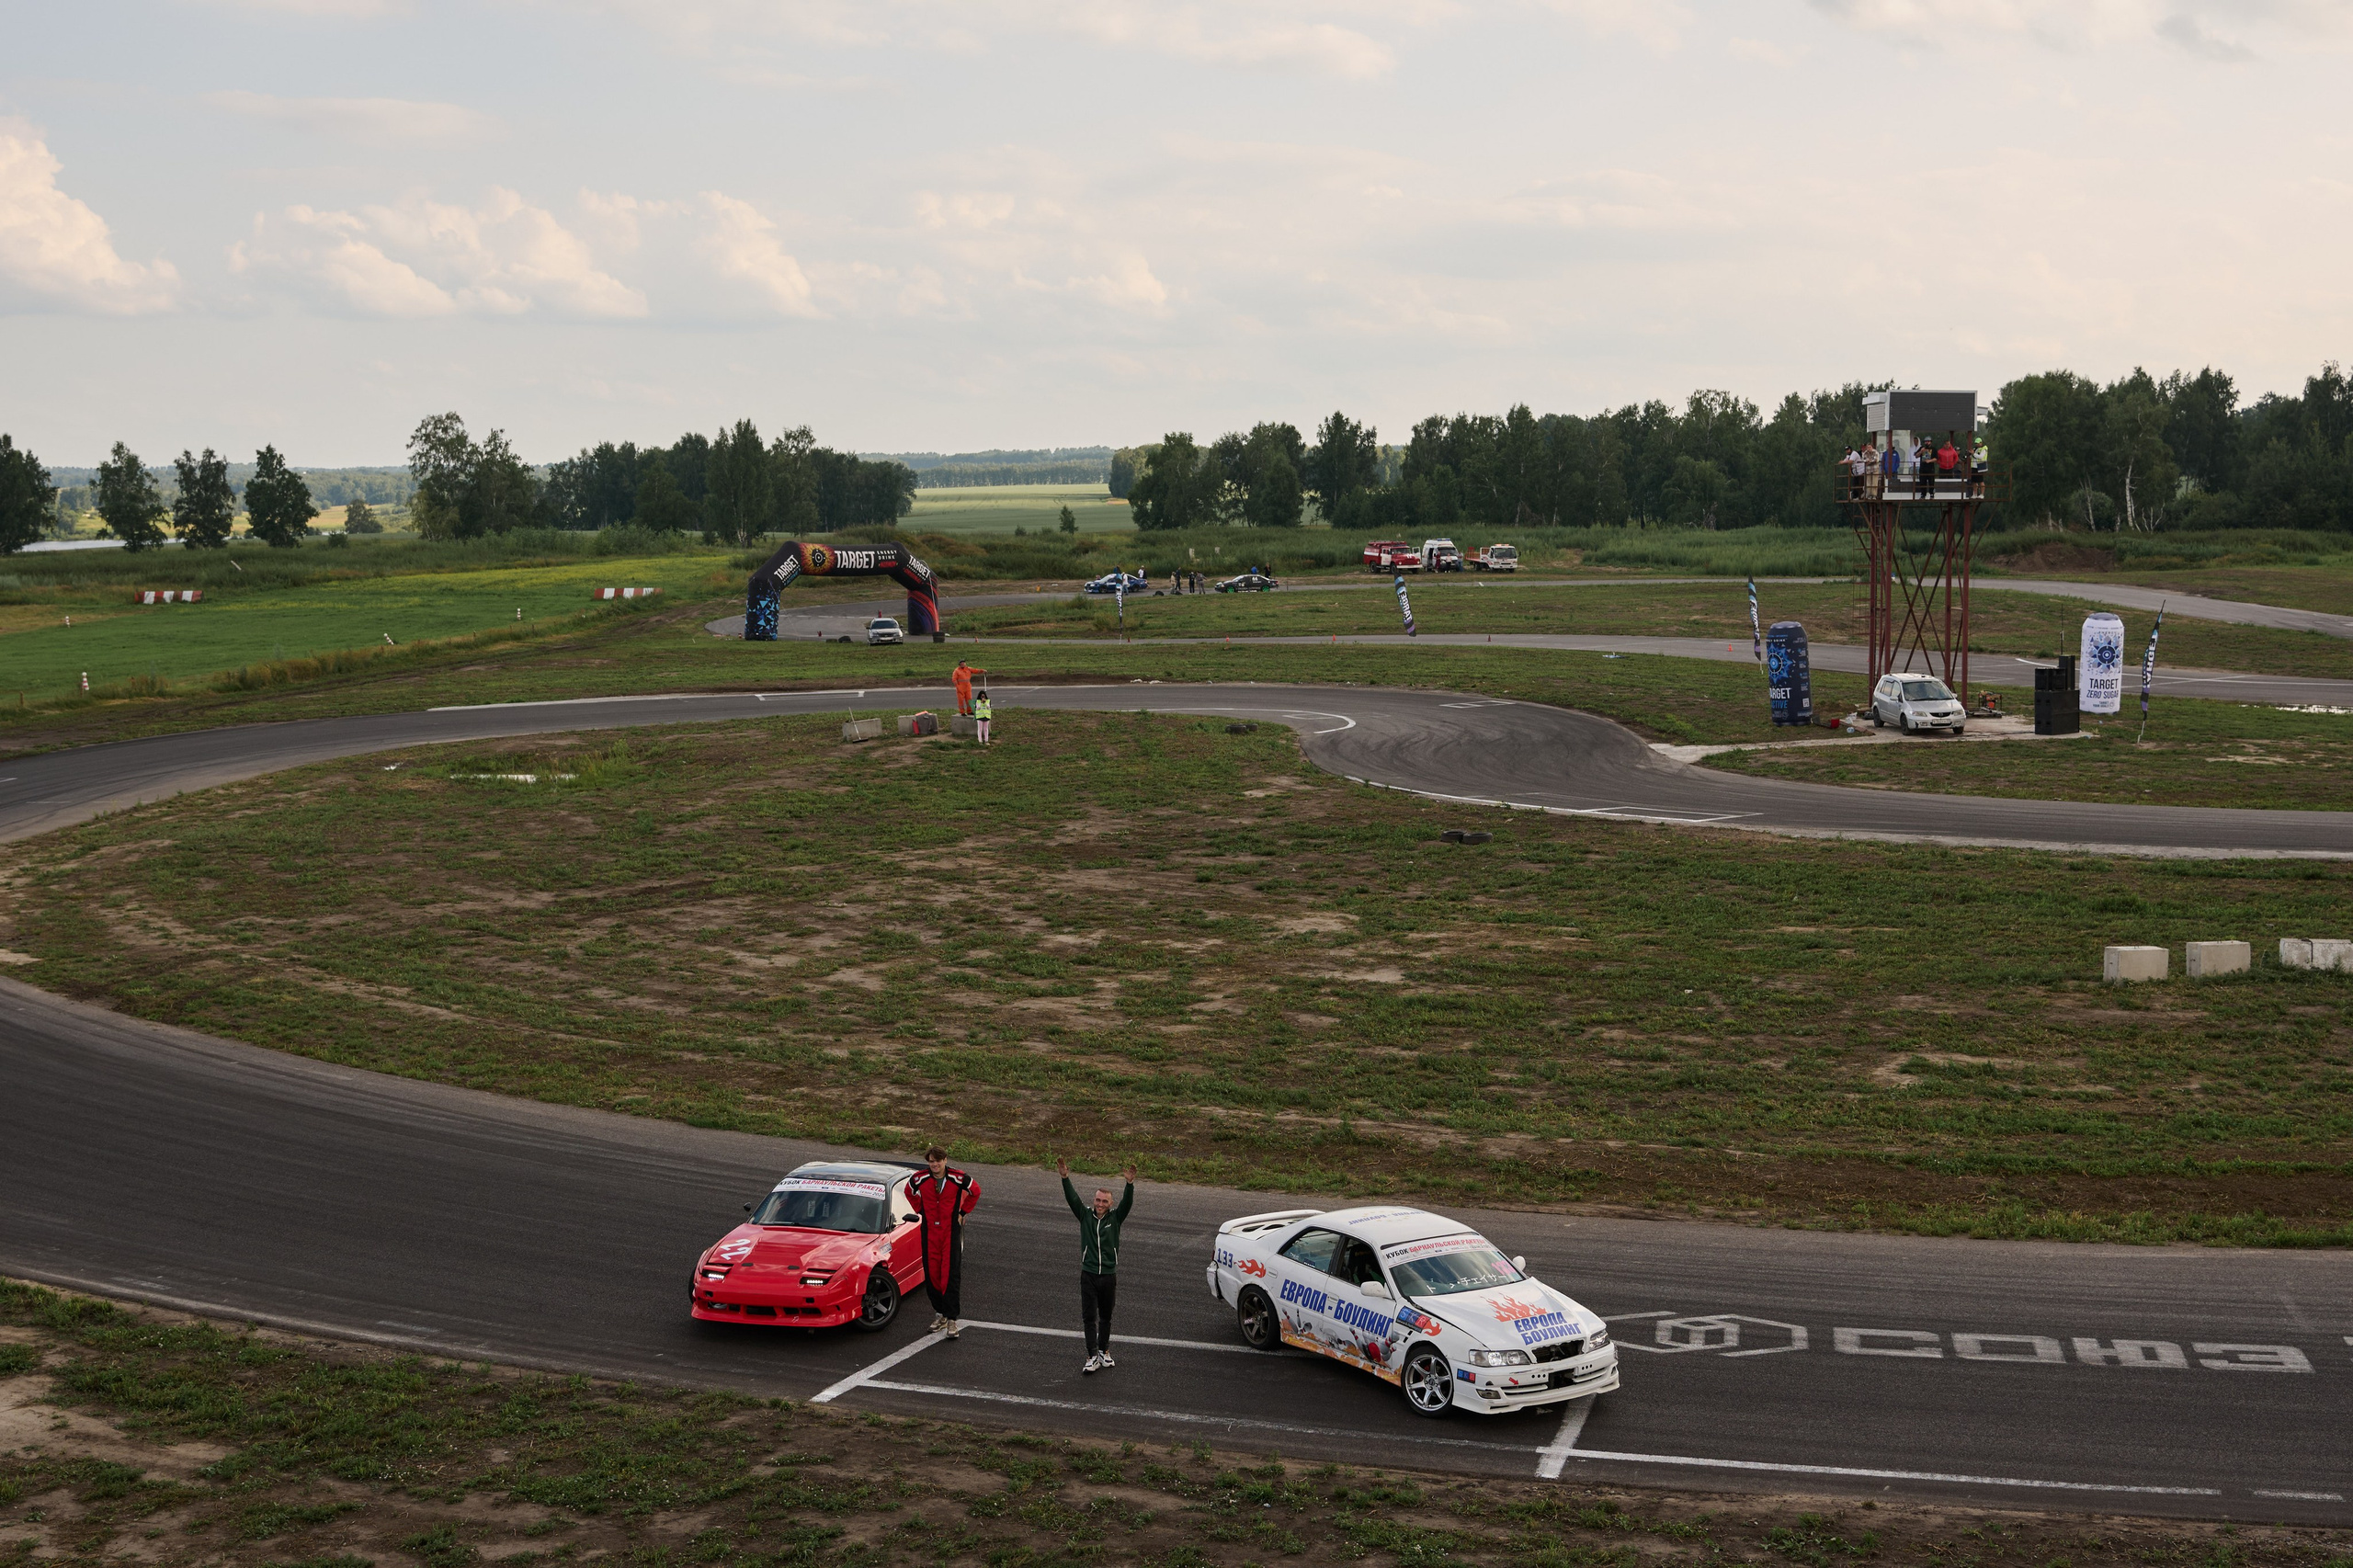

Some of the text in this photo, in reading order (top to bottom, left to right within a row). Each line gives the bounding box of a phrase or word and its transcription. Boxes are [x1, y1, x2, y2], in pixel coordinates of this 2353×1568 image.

[774, 554, 800, 580] TARGET
[835, 551, 875, 569] TARGET
[908, 554, 931, 577] TARGET
[1769, 687, 1791, 699] ARGET
[2089, 678, 2119, 689] TARGET
[1771, 700, 1788, 709] CTIVE
[2086, 690, 2102, 699] ZERO
[857, 1184, 885, 1193] РАКЕТЫ
[720, 1238, 752, 1260] 22
[1217, 1247, 1233, 1268] 133
[1385, 1247, 1410, 1259] КУБОК
[1409, 1240, 1461, 1253] БАРНАУЛЬСКОЙ
[1279, 1278, 1328, 1314] ЕВРОПА
[1334, 1298, 1394, 1338] БОУЛИНГ
[1400, 1307, 1427, 1325] SKR
[1514, 1311, 1567, 1334] ЕВРОПА
[1520, 1324, 1582, 1346] БОУЛИНГ
[1834, 1326, 2315, 1373] СОЮЗ
